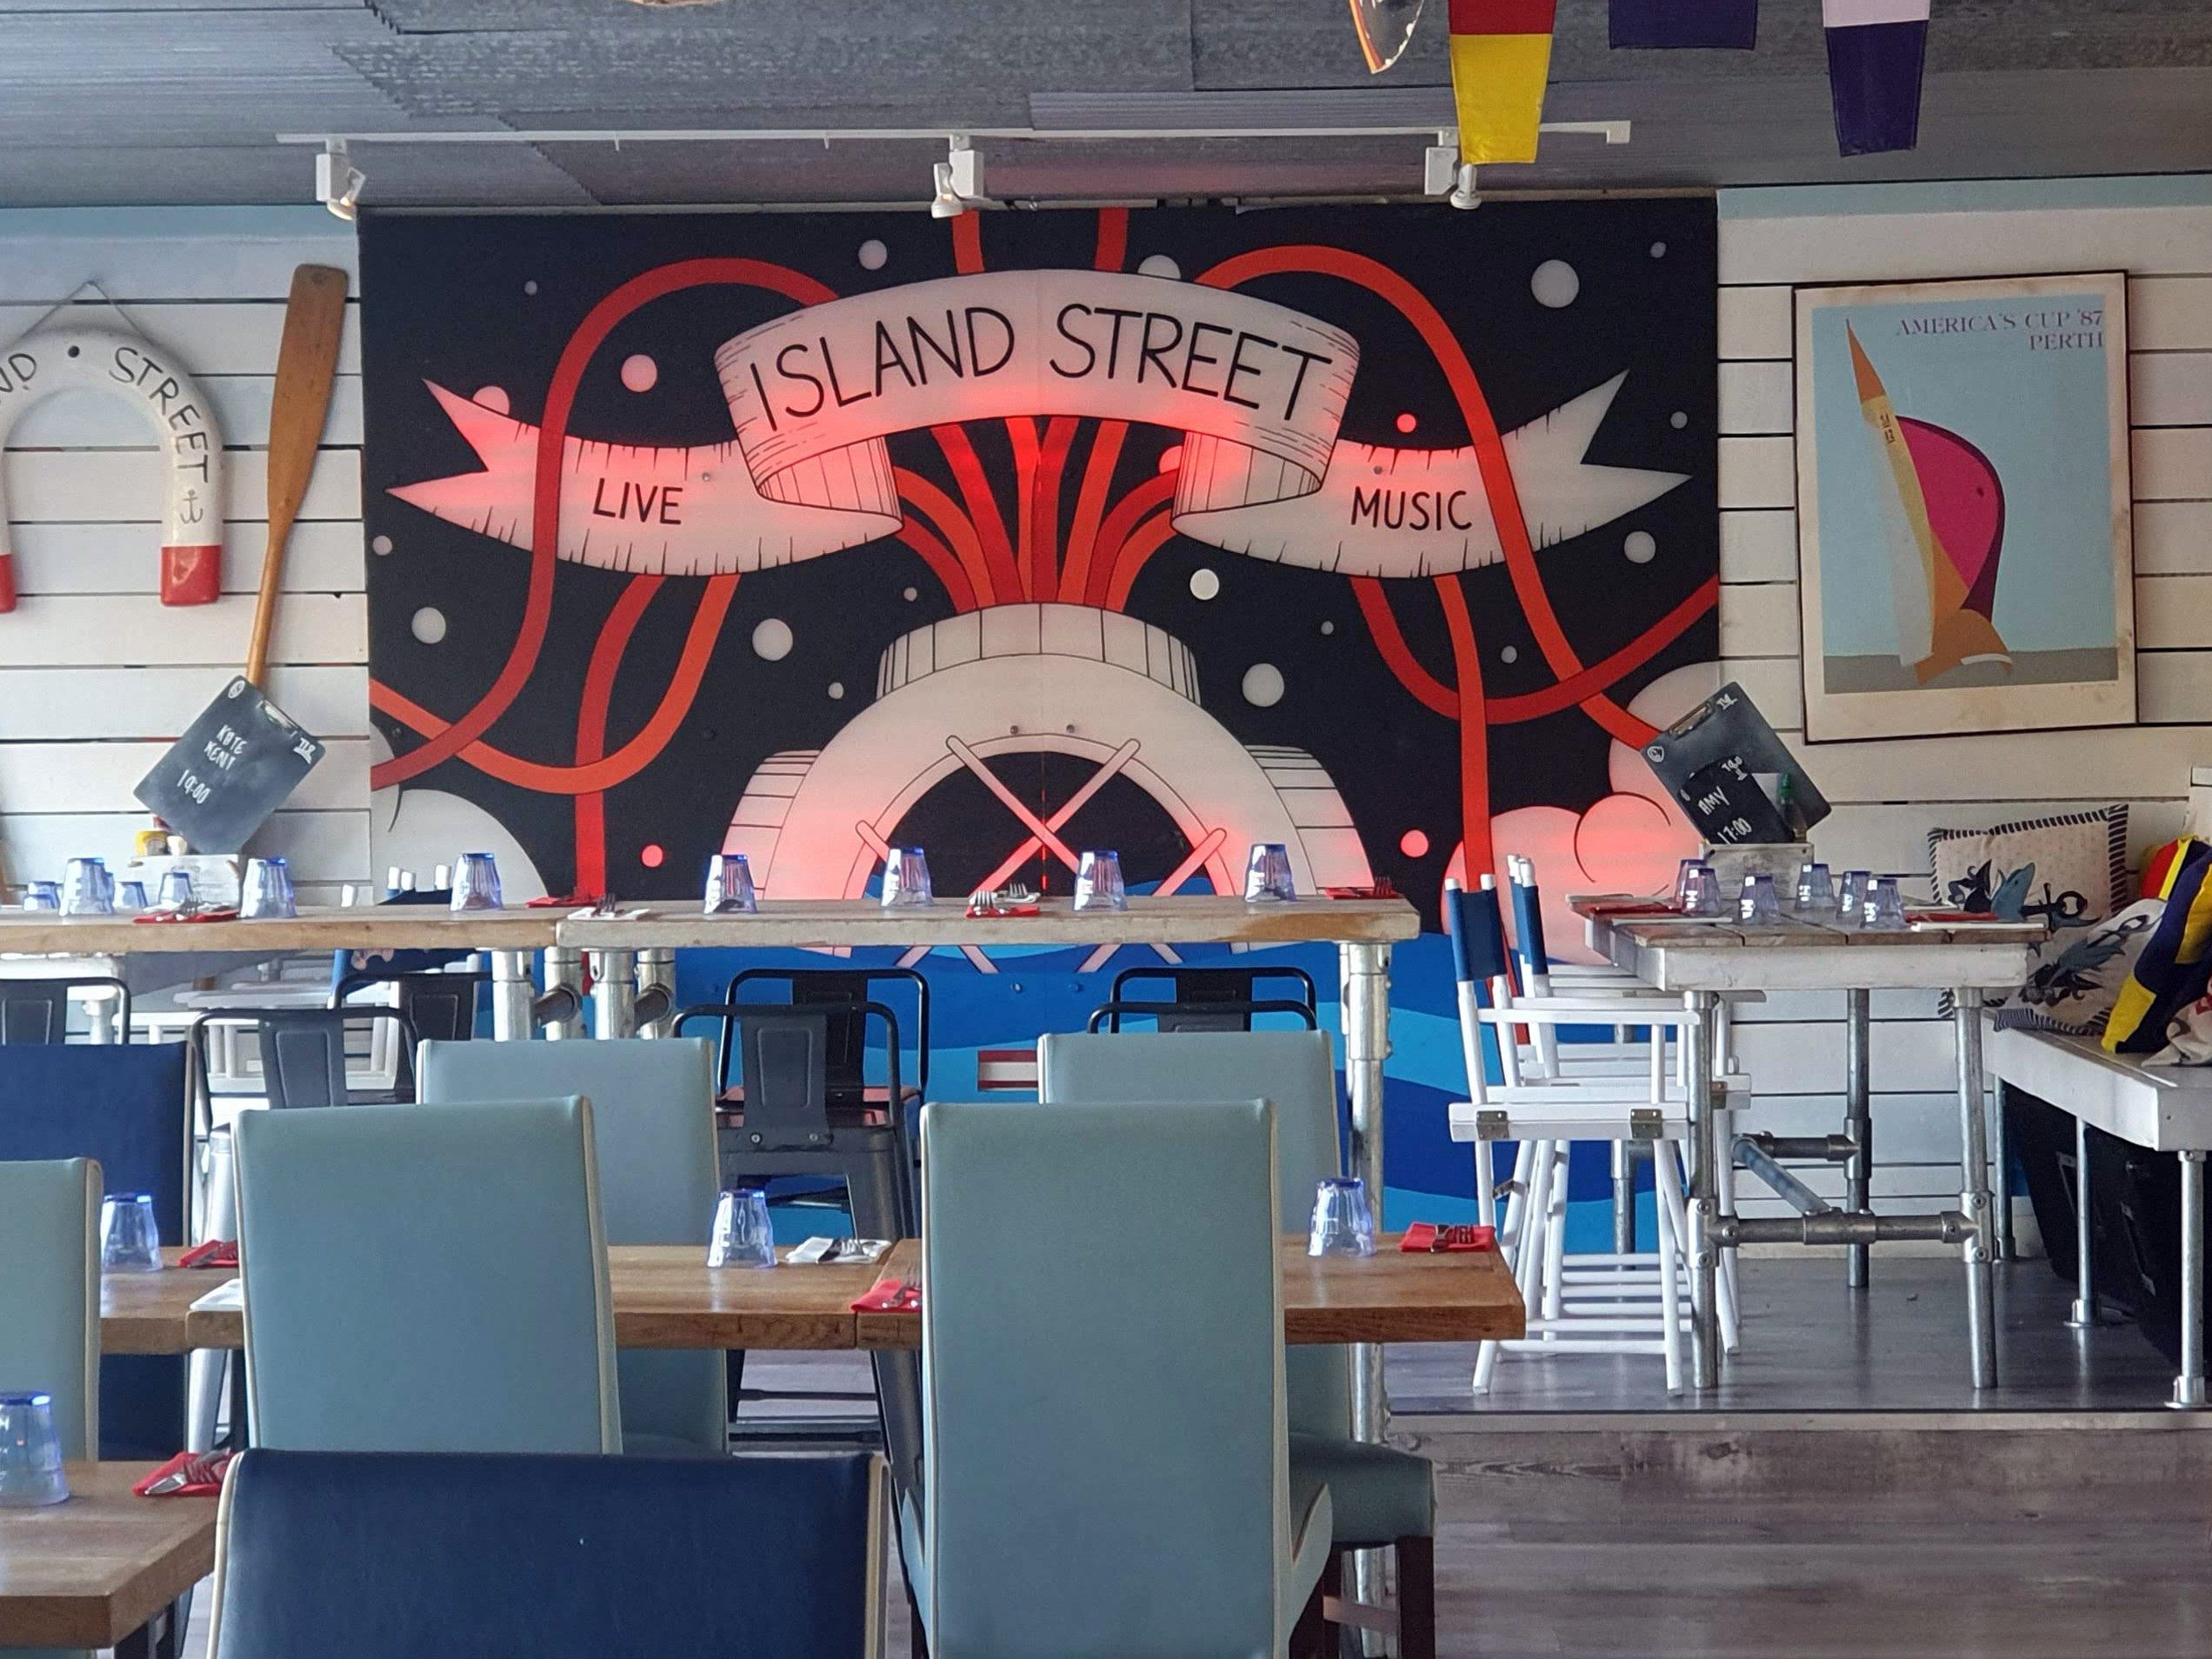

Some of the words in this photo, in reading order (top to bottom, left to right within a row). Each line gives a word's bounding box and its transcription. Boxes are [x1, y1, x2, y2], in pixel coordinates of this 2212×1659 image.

[1896, 311, 2016, 336] AMERICA'S
[2024, 310, 2070, 331] CUP
[2029, 331, 2104, 352] PERTH
[750, 306, 1015, 431] ISLAND
[1049, 303, 1333, 421] STREET
[110, 346, 210, 483] STREET
[592, 477, 683, 527] LIVE
[1350, 486, 1472, 532] MUSIC
[203, 739, 237, 771] KENT
[1697, 785, 1730, 816] AMY
